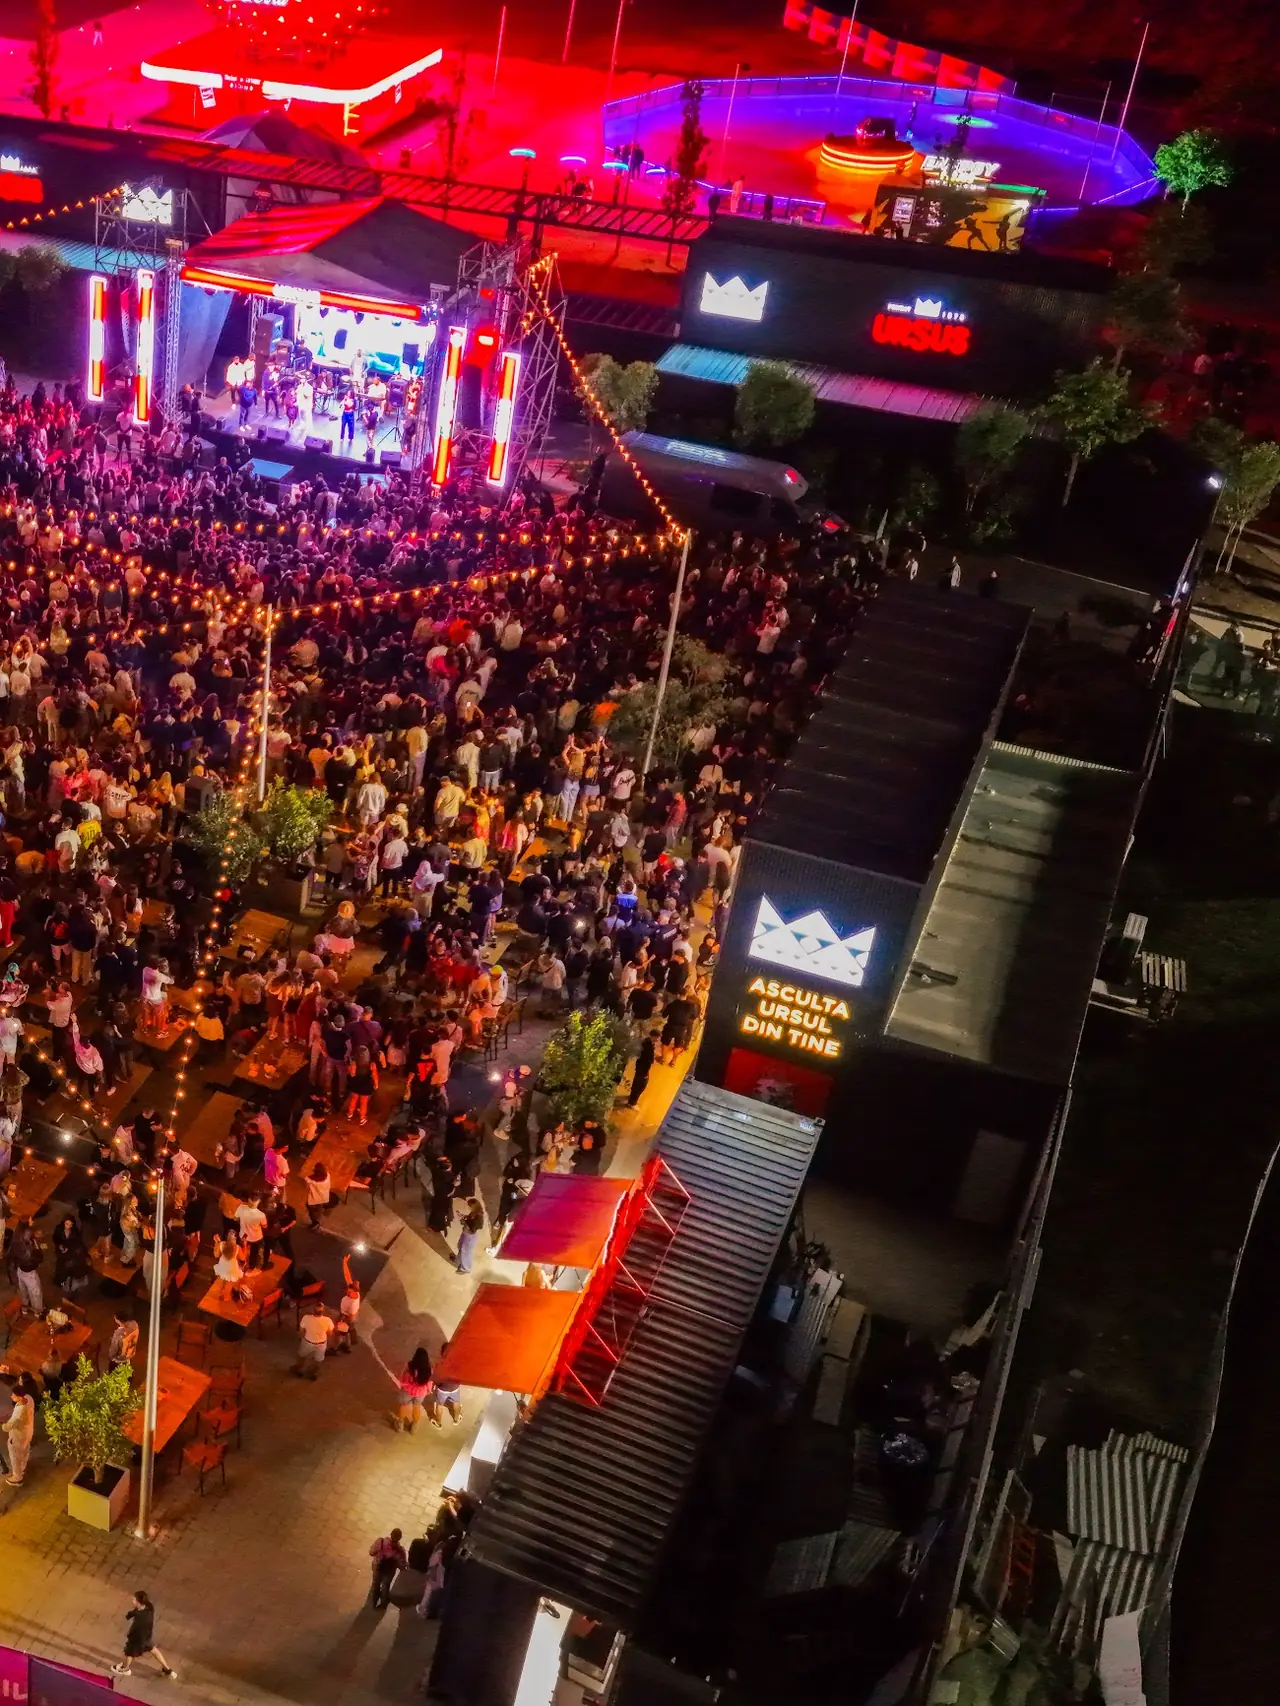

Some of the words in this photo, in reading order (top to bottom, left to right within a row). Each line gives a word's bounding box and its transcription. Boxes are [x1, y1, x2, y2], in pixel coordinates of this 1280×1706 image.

[871, 313, 971, 356] URSUS
[748, 976, 851, 1020] ASCULTA
[758, 998, 832, 1035] URSUL
[741, 1015, 783, 1041] DIN
[788, 1027, 841, 1058] TINE
